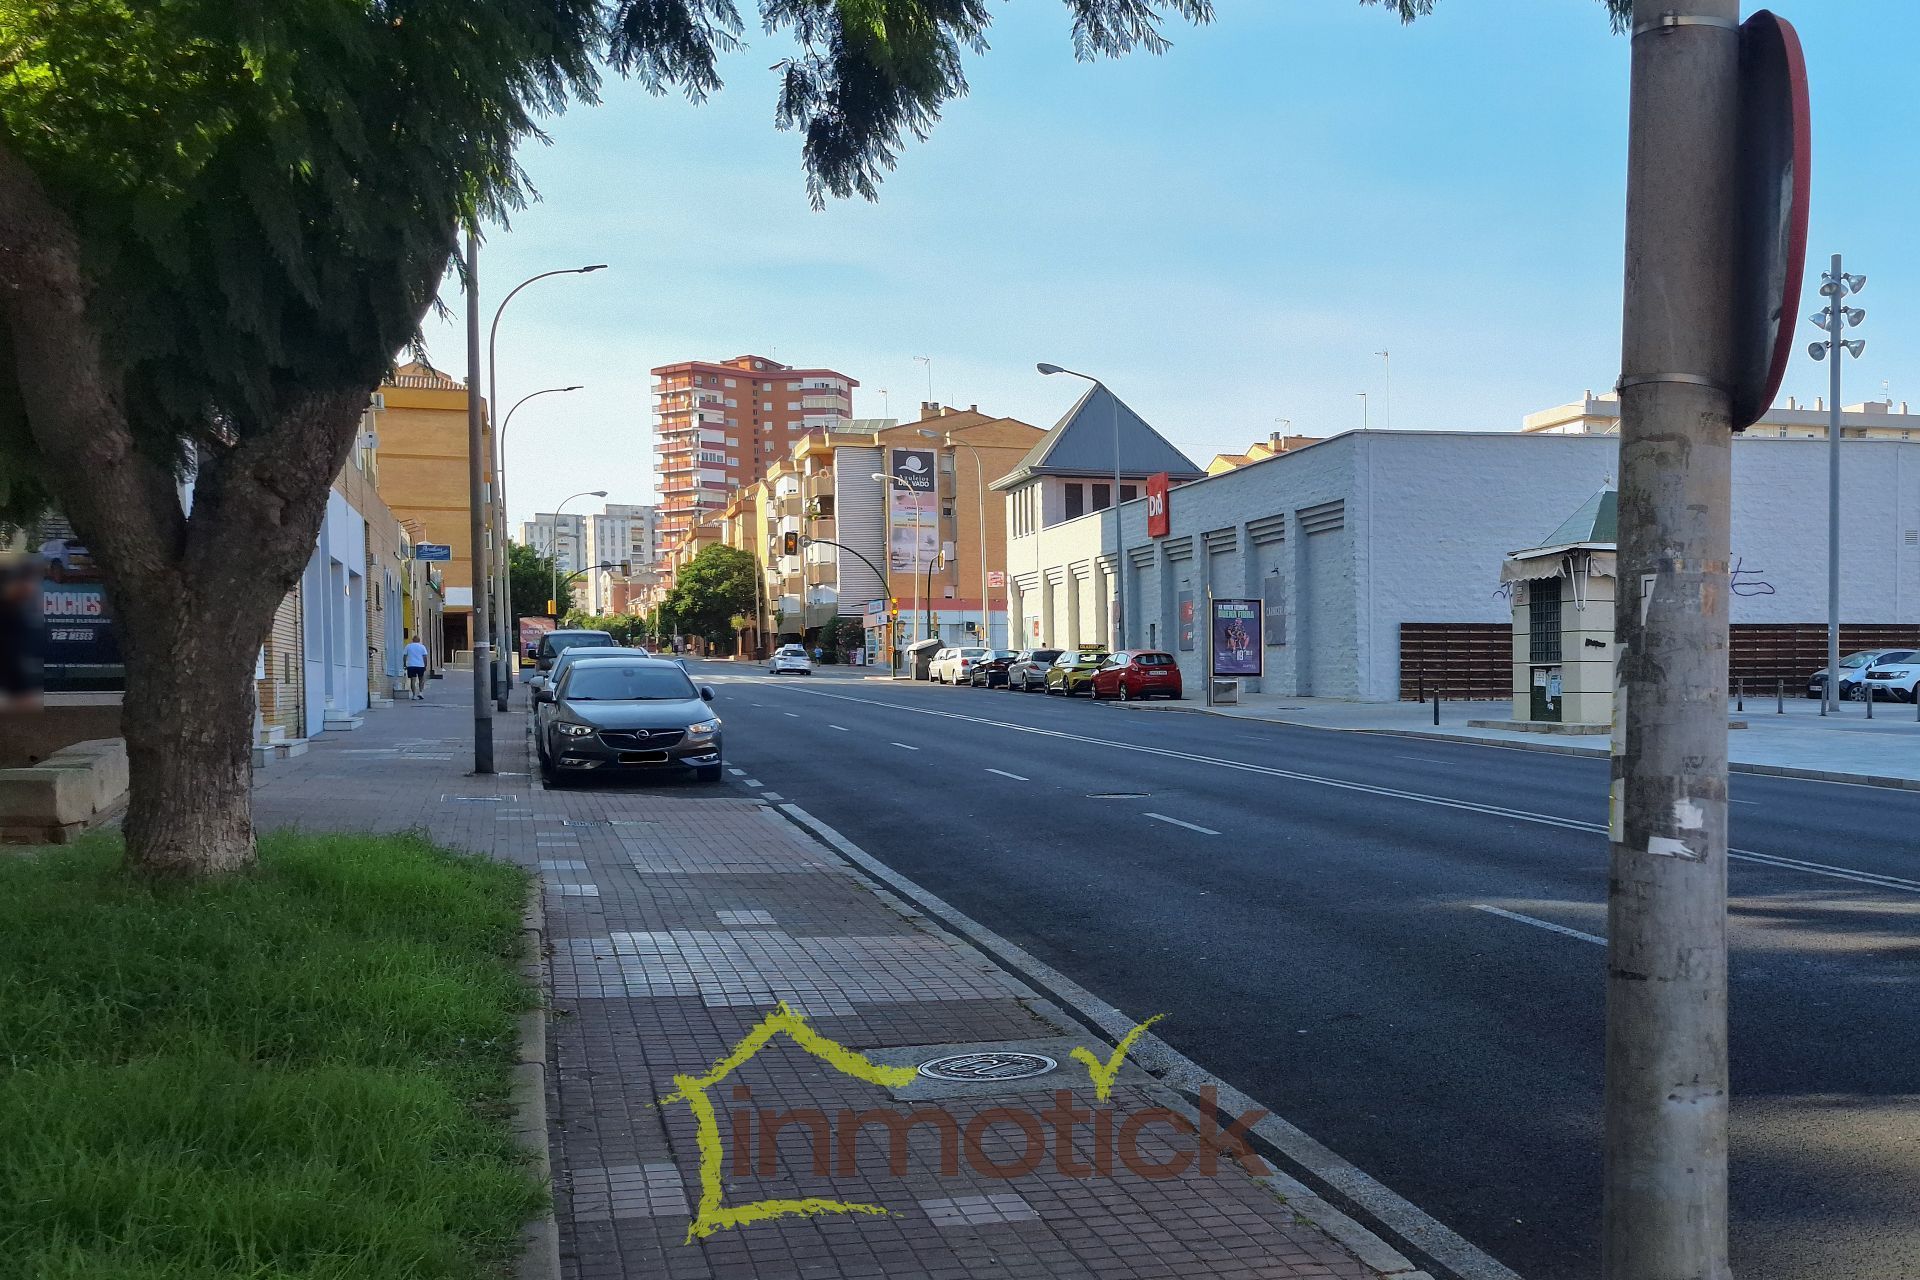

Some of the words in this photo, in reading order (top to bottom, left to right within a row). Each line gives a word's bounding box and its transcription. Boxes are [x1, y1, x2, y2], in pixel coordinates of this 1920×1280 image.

[44, 592, 102, 616] COCHES
[51, 632, 67, 640] 12
[68, 632, 94, 641] MESES
